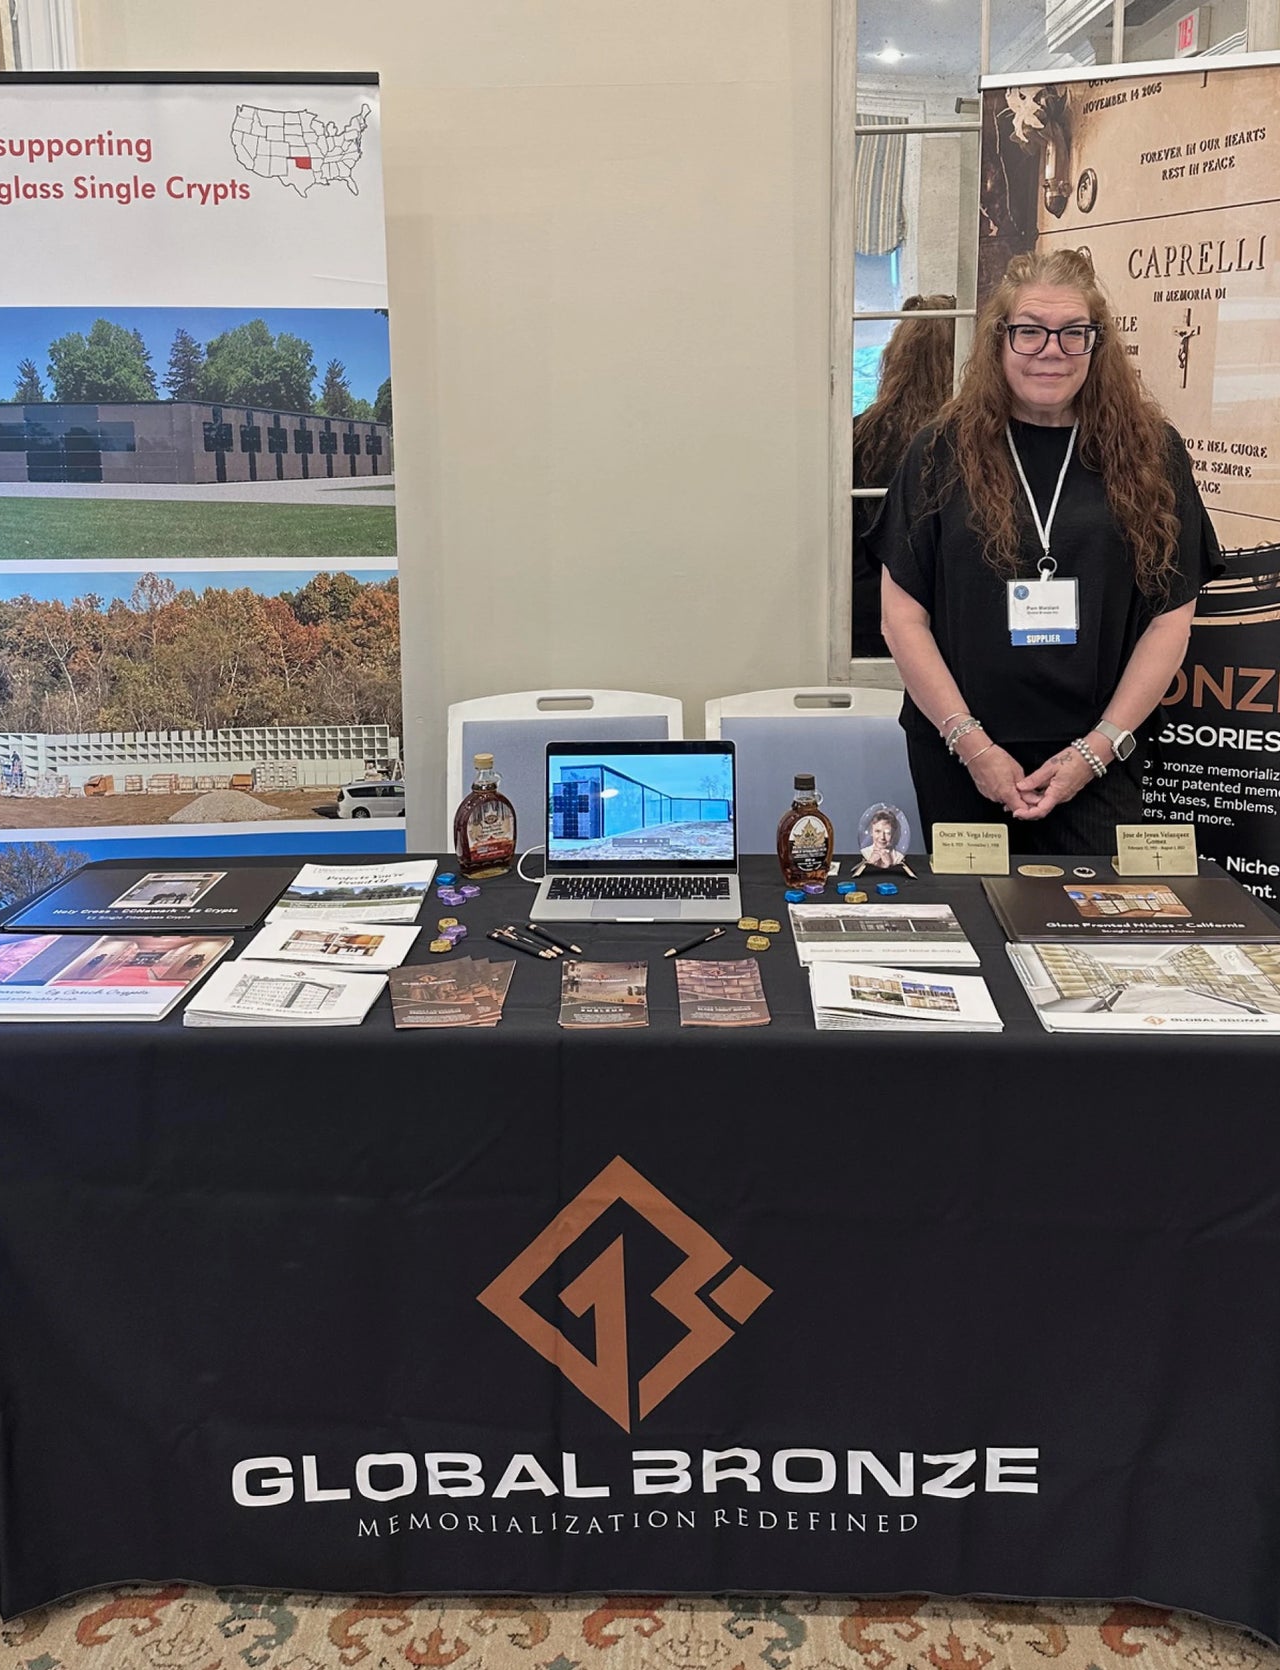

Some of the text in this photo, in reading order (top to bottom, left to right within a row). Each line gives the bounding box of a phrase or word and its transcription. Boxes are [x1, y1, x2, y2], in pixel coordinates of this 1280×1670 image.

[1082, 91, 1127, 114] NOVEMBER
[1142, 82, 1163, 97] 2005
[1140, 127, 1267, 165] FOREVER IN OUR HEARTS
[1162, 156, 1235, 181] REST IN PEACE
[73, 175, 156, 205] Single
[165, 176, 251, 205] Crypts
[1128, 235, 1267, 279] CAPRELLI
[1153, 288, 1226, 302] IN MEMORIA DI
[1197, 439, 1204, 451] E
[1207, 440, 1227, 453] NEL
[1231, 443, 1268, 458] CUORE
[1211, 462, 1252, 478] SEMPRE
[1026, 634, 1061, 643] SUPPLIER
[1156, 776, 1179, 788] our
[1182, 778, 1241, 795] patented
[1169, 792, 1210, 809] Vases,
[1214, 797, 1277, 815] Emblems,
[1170, 809, 1194, 821] and
[1197, 814, 1235, 826] more.
[939, 830, 956, 838] Oscar
[966, 831, 981, 840] Vega
[232, 1447, 1040, 1507] GLOBAL BRONZE
[357, 1507, 919, 1538] MEMORIALIZATION REDEFINED
